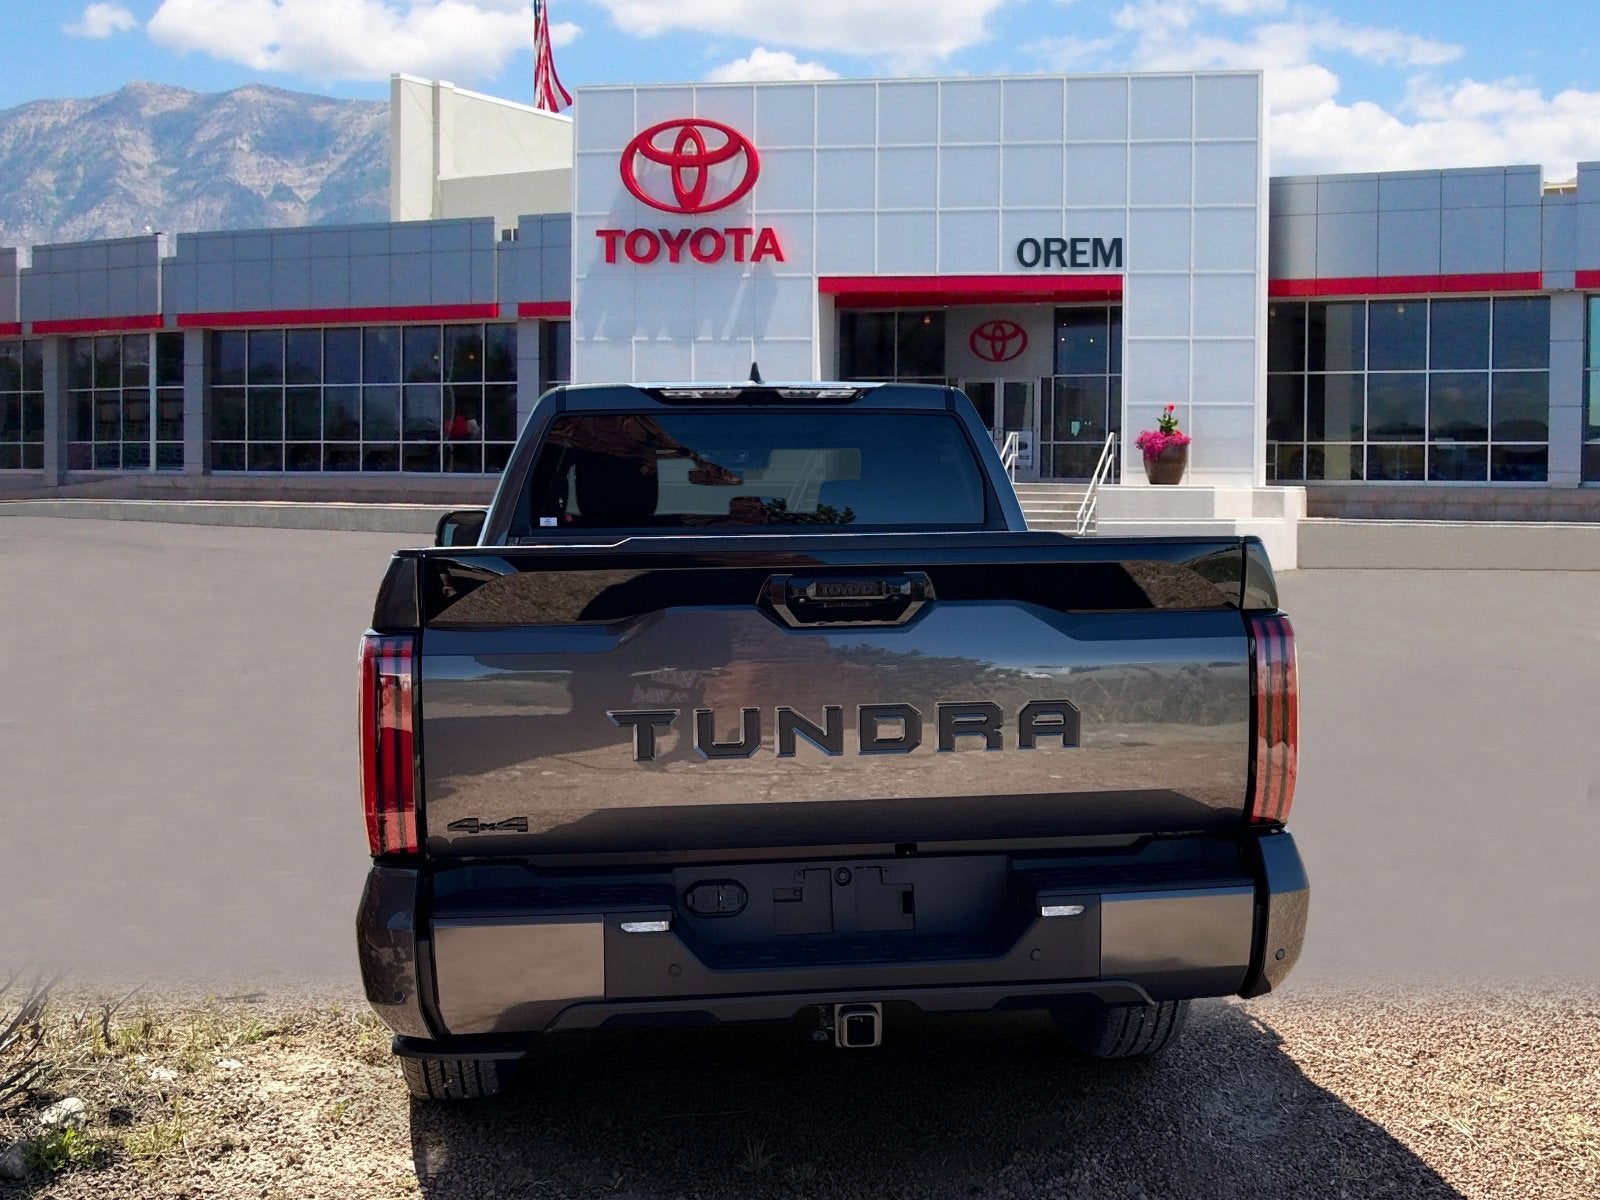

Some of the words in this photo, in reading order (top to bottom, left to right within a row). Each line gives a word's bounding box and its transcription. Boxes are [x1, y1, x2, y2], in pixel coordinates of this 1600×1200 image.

[596, 227, 784, 265] TOYOTA
[1017, 238, 1122, 267] OREM
[821, 582, 879, 596] TOYOTA
[607, 700, 1081, 761] TUNDRA
